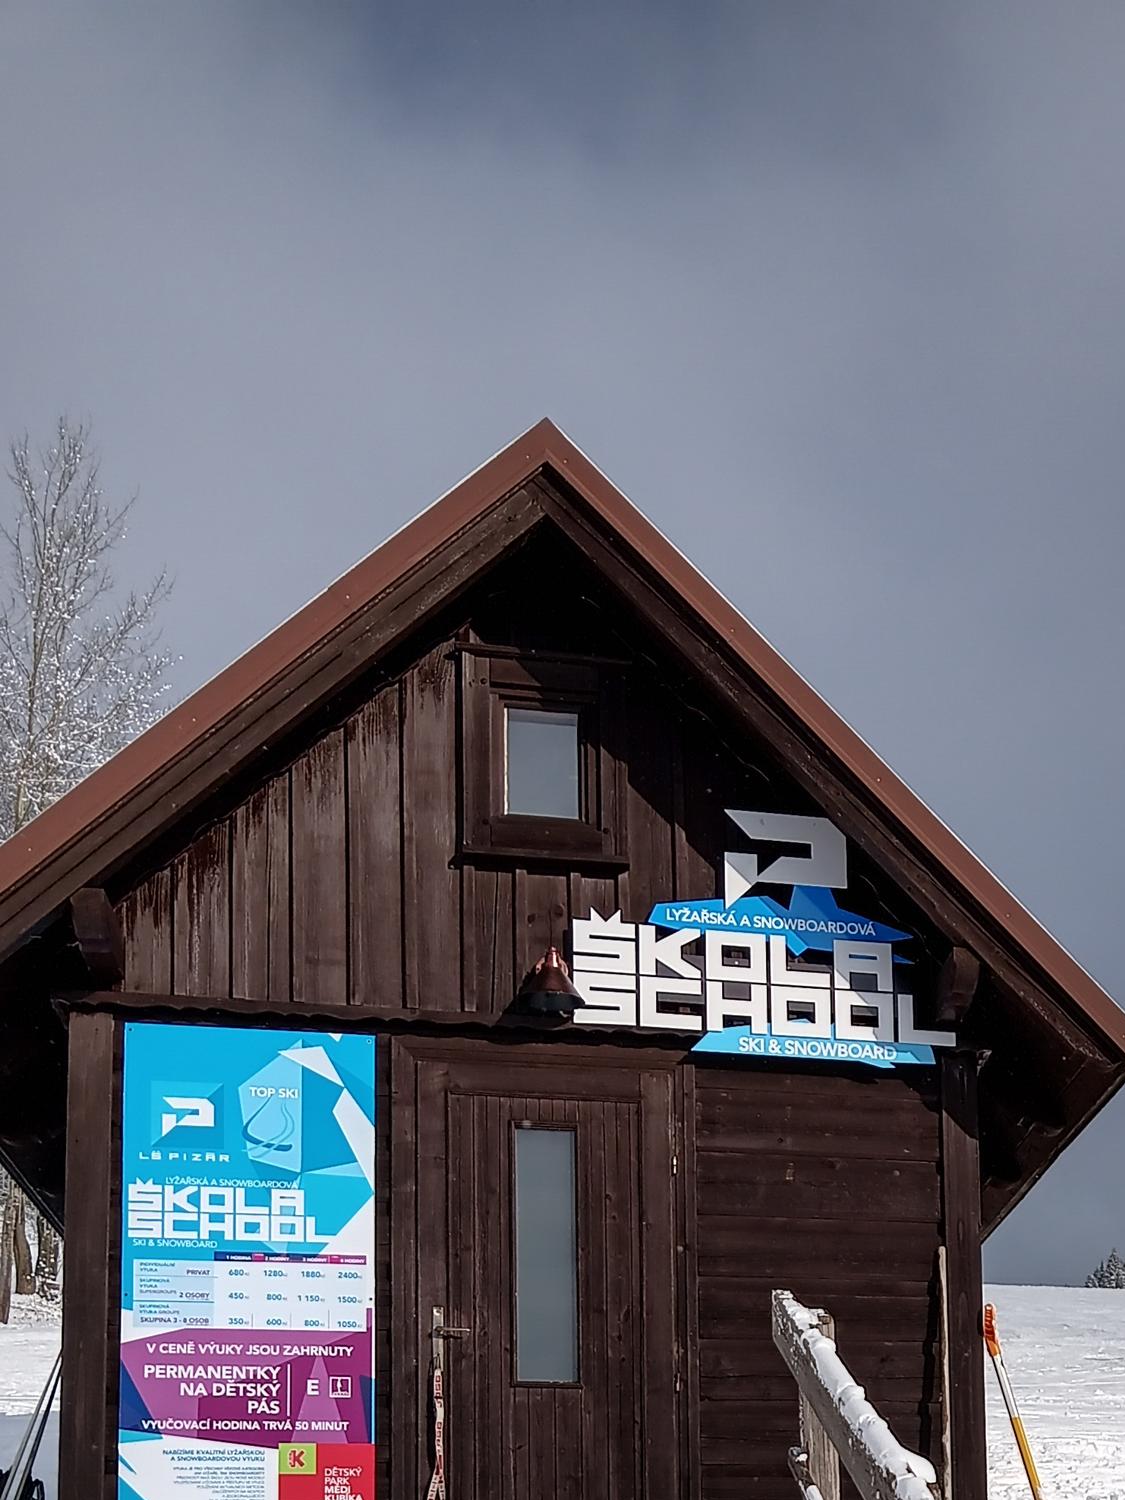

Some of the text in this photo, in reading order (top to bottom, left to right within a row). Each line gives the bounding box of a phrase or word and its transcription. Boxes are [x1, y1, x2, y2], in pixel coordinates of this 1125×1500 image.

[666, 907, 876, 936] LYŽAŘSKÁ A SNOWBOARDOVÁ
[572, 906, 893, 991] ŠKOLA
[572, 971, 957, 1047] SCHOOL
[738, 1036, 898, 1061] SKI & SNOWBOARD
[249, 1086, 299, 1099] TOP SKI
[165, 1176, 298, 1189] LYŽAŘSKÁ A SNOWBOARDOVÁ
[128, 1177, 305, 1216] ŠKOLA
[128, 1211, 337, 1243] SCHOOL
[133, 1239, 147, 1247] SKI
[156, 1240, 218, 1249] SNOWBOARD
[338, 1271, 358, 1279] 2400
[266, 1293, 282, 1301] 800
[228, 1317, 244, 1325] 350
[266, 1318, 282, 1326] 600
[304, 1319, 320, 1327] 800
[337, 1320, 357, 1328] 1050
[146, 1341, 354, 1357] V CENĚ VÝUKY JSOU ZAHRNUTY
[144, 1364, 281, 1380] PERMANENTKY
[180, 1380, 281, 1397] NA DĚTSKÝ
[306, 1379, 320, 1395] E
[247, 1397, 280, 1414] PÁS
[141, 1418, 350, 1431] VYUČOVACÍ HODINA TRVÁ 50 MINUT
[324, 1467, 362, 1477] DĚTSKÝ
[324, 1477, 350, 1485] PARK
